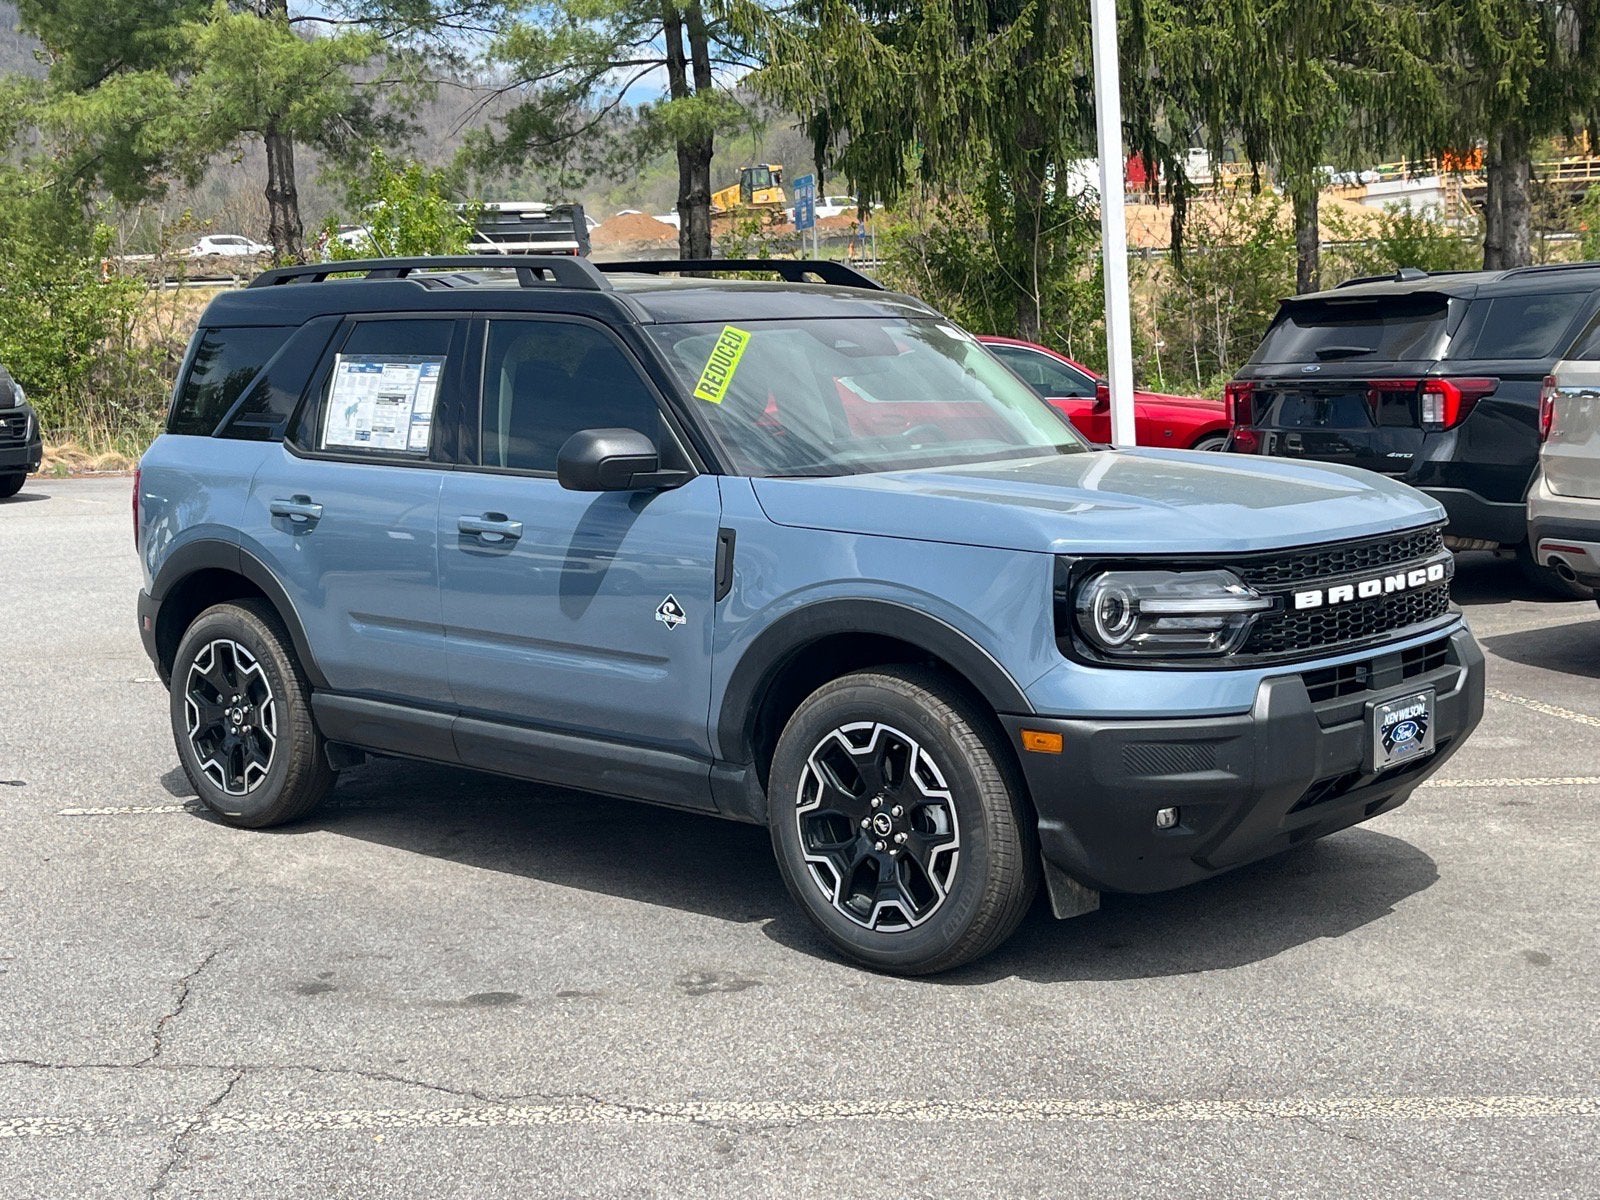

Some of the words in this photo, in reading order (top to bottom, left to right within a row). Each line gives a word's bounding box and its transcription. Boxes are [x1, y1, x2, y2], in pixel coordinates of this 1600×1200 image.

[698, 331, 743, 397] REDUCED
[1295, 564, 1444, 609] BRONCO
[1384, 712, 1399, 725] KEN
[1399, 703, 1425, 720] WILSON
[1396, 723, 1414, 740] Ford
